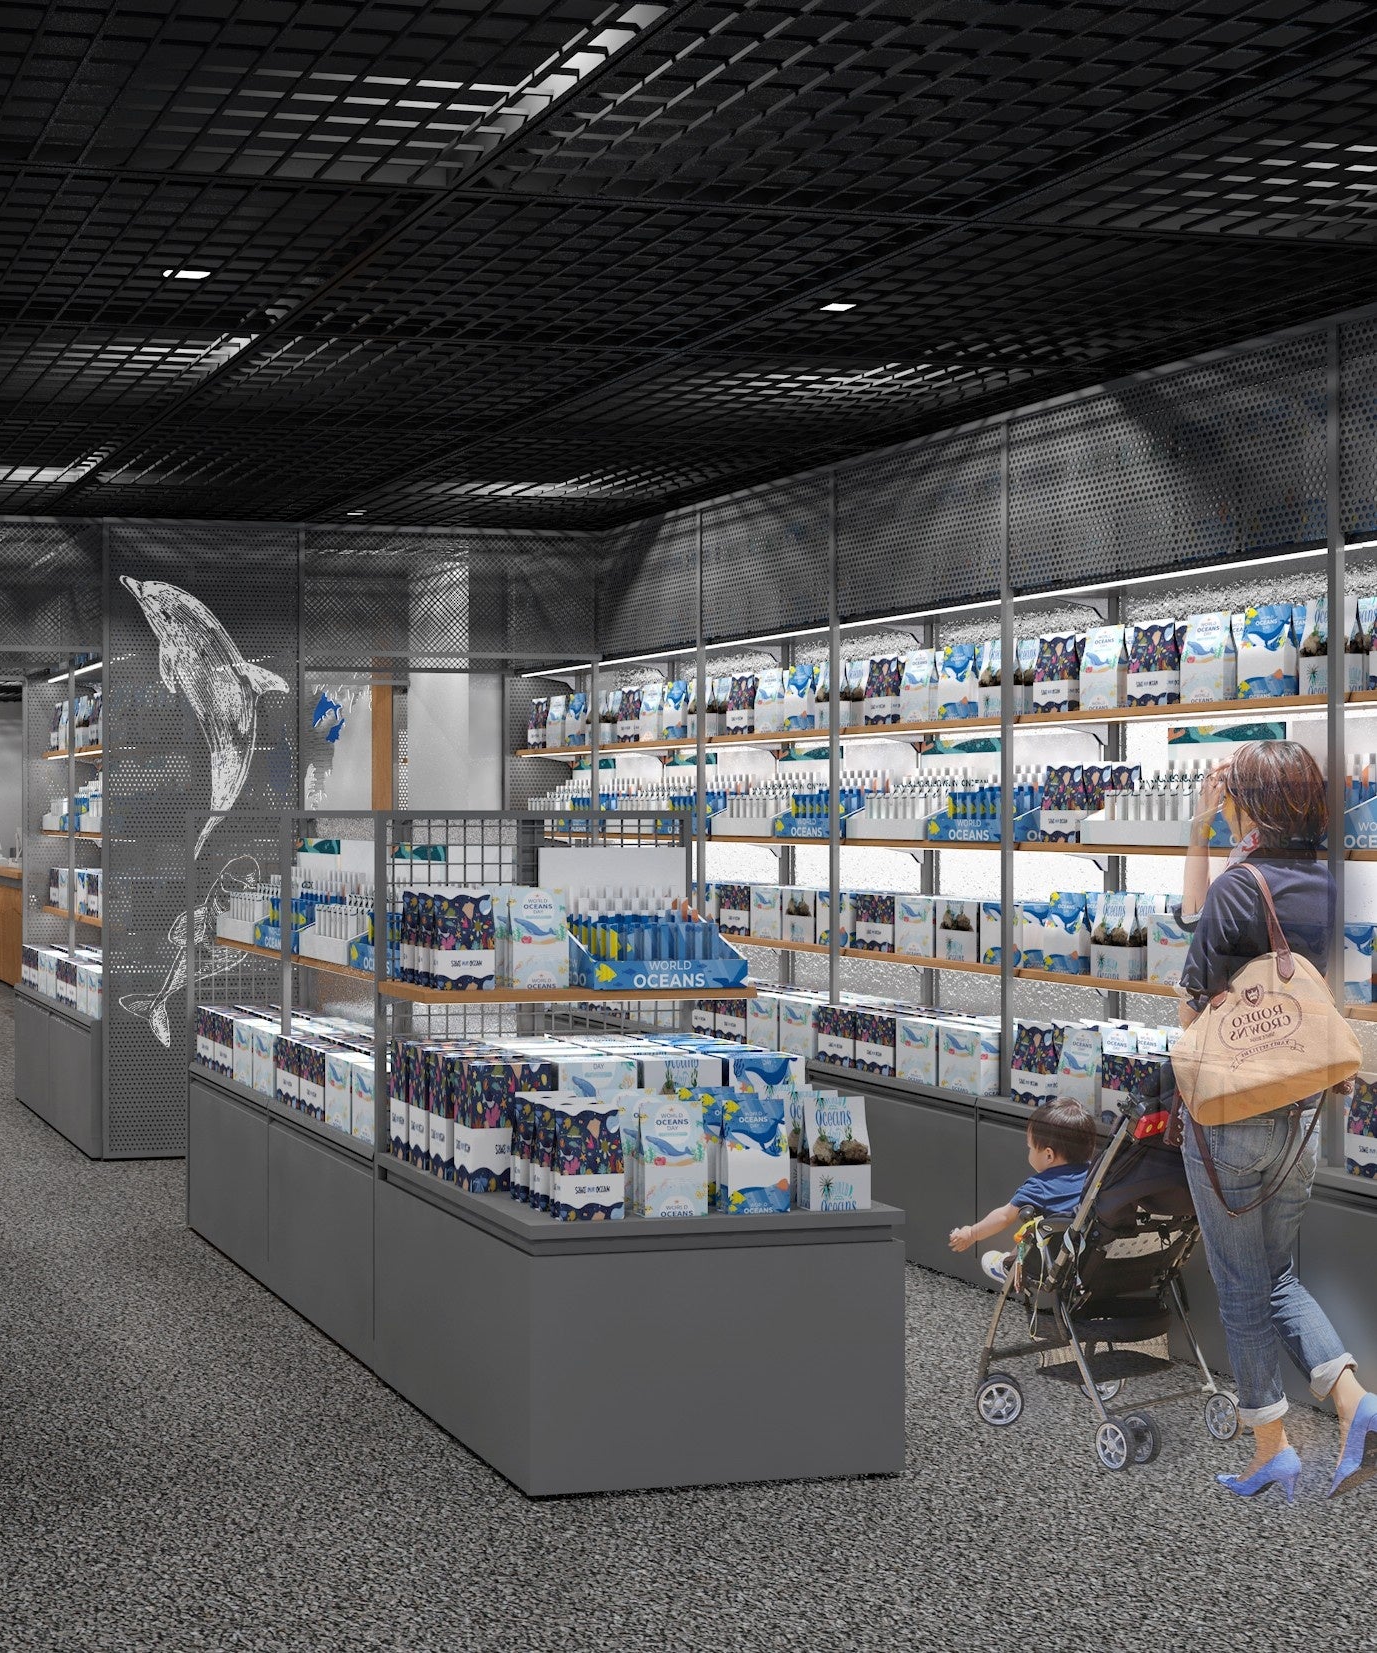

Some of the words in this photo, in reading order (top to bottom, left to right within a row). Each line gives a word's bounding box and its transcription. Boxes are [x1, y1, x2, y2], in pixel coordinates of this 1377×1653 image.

[791, 827, 822, 837] OCEANS
[949, 829, 989, 840] OCEANS
[1344, 835, 1377, 848] OCE
[265, 936, 281, 949] OCEAN
[649, 961, 691, 970] WORLD
[634, 974, 705, 988] OCEANS
[815, 1110, 851, 1127] Oceans
[574, 1186, 586, 1194] SAVE
